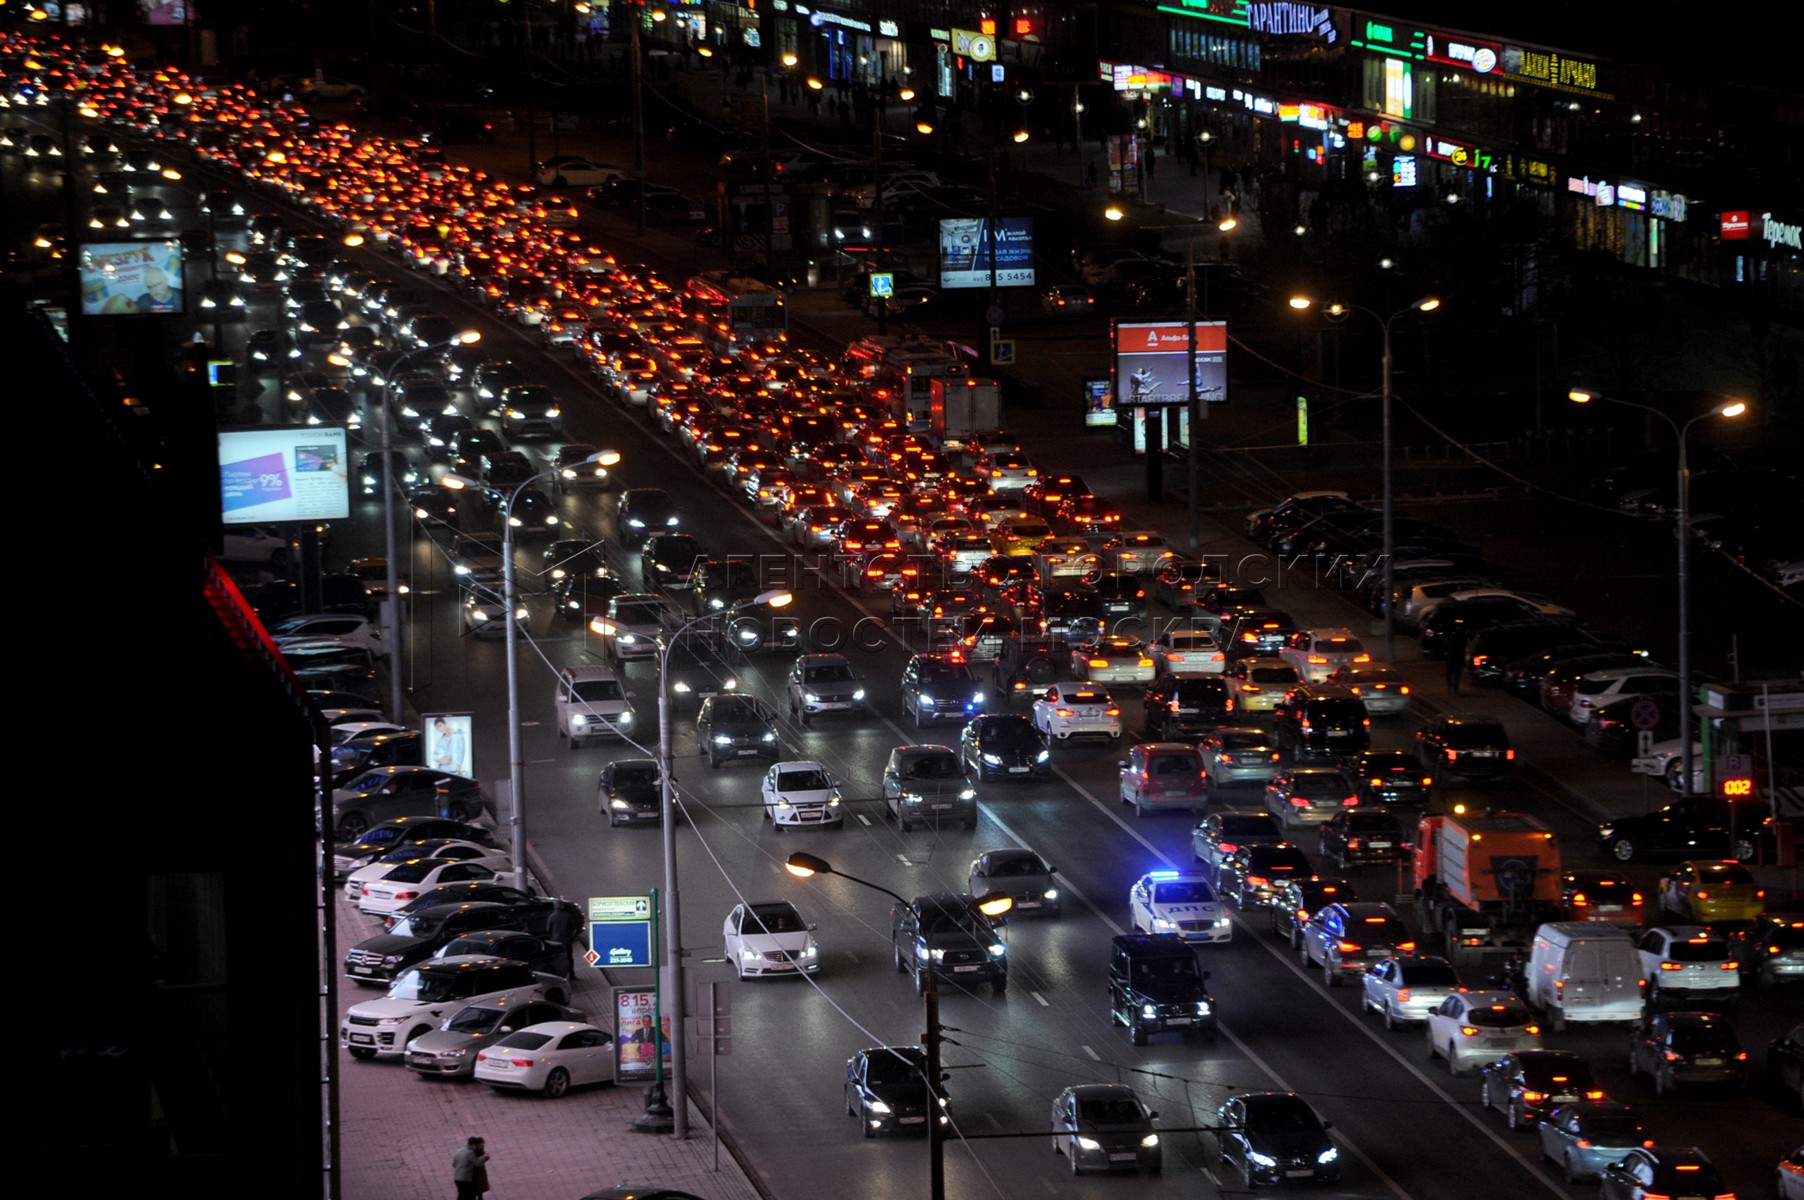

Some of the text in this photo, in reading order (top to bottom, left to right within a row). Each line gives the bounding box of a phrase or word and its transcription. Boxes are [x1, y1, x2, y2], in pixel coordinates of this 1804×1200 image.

[1246, 2, 1315, 34] ТАРАНТИНО
[1520, 51, 1596, 89] ЛАККИ ЛУЧАНО
[1762, 212, 1802, 249] Теремок
[985, 272, 1003, 281] 85
[1007, 272, 1032, 281] 5454
[260, 473, 283, 488] 9%
[1724, 780, 1751, 795] 002
[1168, 904, 1215, 913] ДПС
